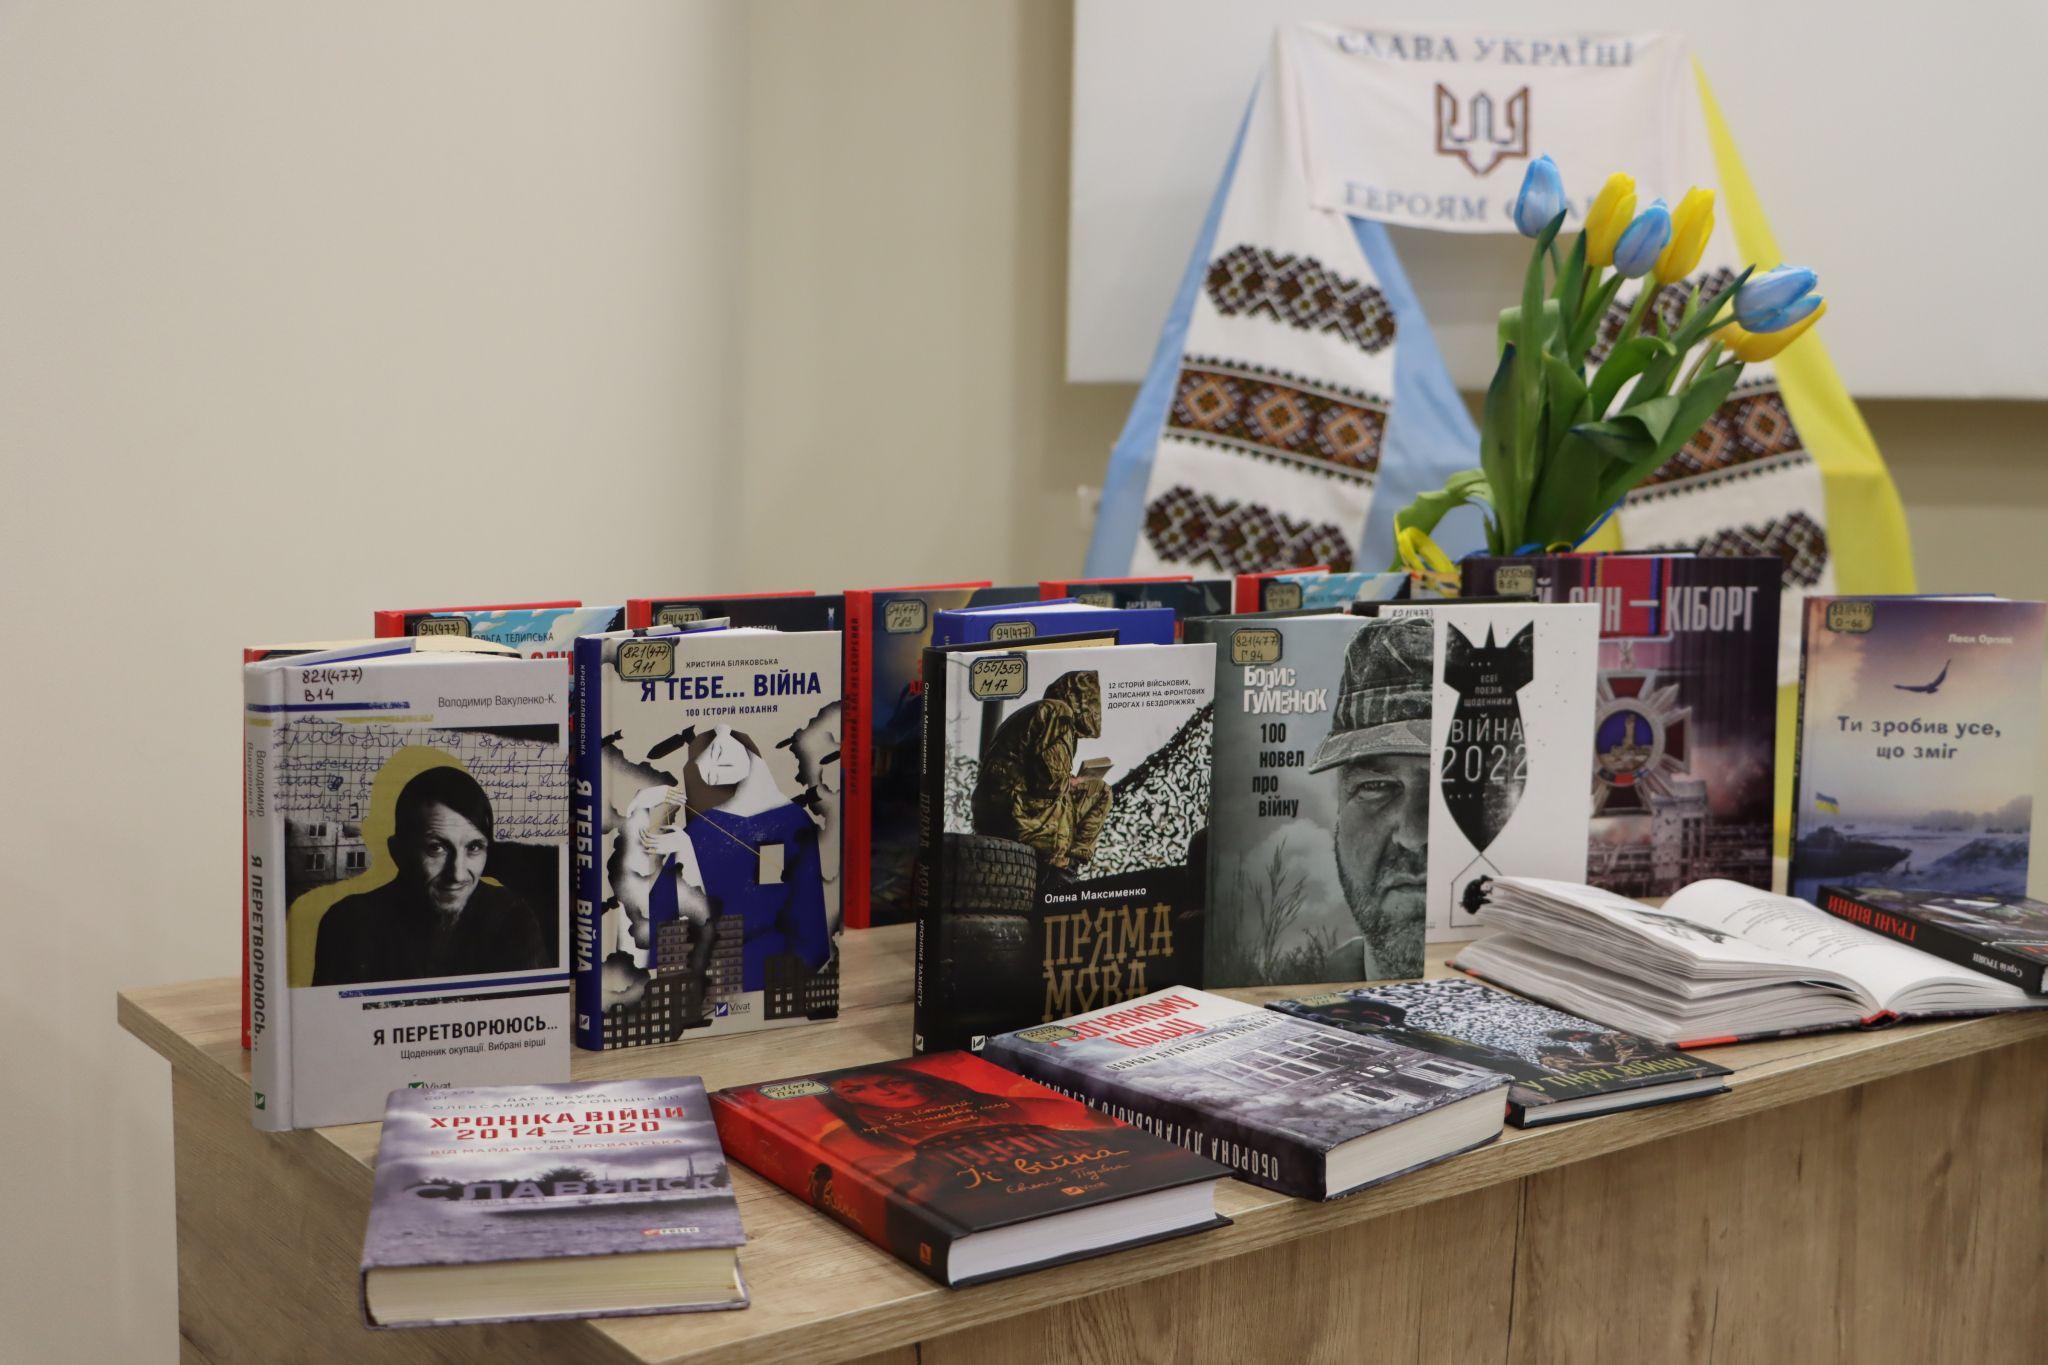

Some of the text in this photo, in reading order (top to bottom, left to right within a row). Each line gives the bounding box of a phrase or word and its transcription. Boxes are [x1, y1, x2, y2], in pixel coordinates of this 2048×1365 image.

[1337, 33, 1634, 67] СЛАВА УКРАЇНІ
[1344, 181, 1488, 222] ГЕРОЯМ
[1666, 586, 1758, 632] КІБОРГ
[640, 680, 656, 702] Я
[754, 669, 821, 697] ВІЙНА
[1108, 690, 1150, 699] ЗАПИСАНИХ
[1164, 687, 1206, 697] ФРОНТОВИХ
[438, 696, 492, 709] Володимир
[1107, 700, 1140, 709] ДОРОГАХ
[1260, 723, 1286, 744] 100
[1452, 714, 1525, 744] ВІЙНА
[1838, 716, 1862, 732] Ти
[1871, 718, 1948, 738] зробив
[1259, 750, 1304, 768] новел
[1877, 744, 1958, 760] що зміг
[1441, 745, 1528, 783] 2022
[577, 781, 592, 796] Я
[1252, 776, 1278, 796] про
[1258, 796, 1299, 818] війну
[1044, 886, 1147, 904] Олена Максименко
[577, 901, 596, 972] ВІЙНА
[1043, 902, 1174, 970] ПРЯМА
[373, 1029, 385, 1046] Я
[401, 1046, 446, 1060] Щоденник
[489, 1040, 521, 1051] Вибрані
[524, 1039, 546, 1049] вірші
[430, 1107, 685, 1128] ХРОНІКА ВІЙНИ
